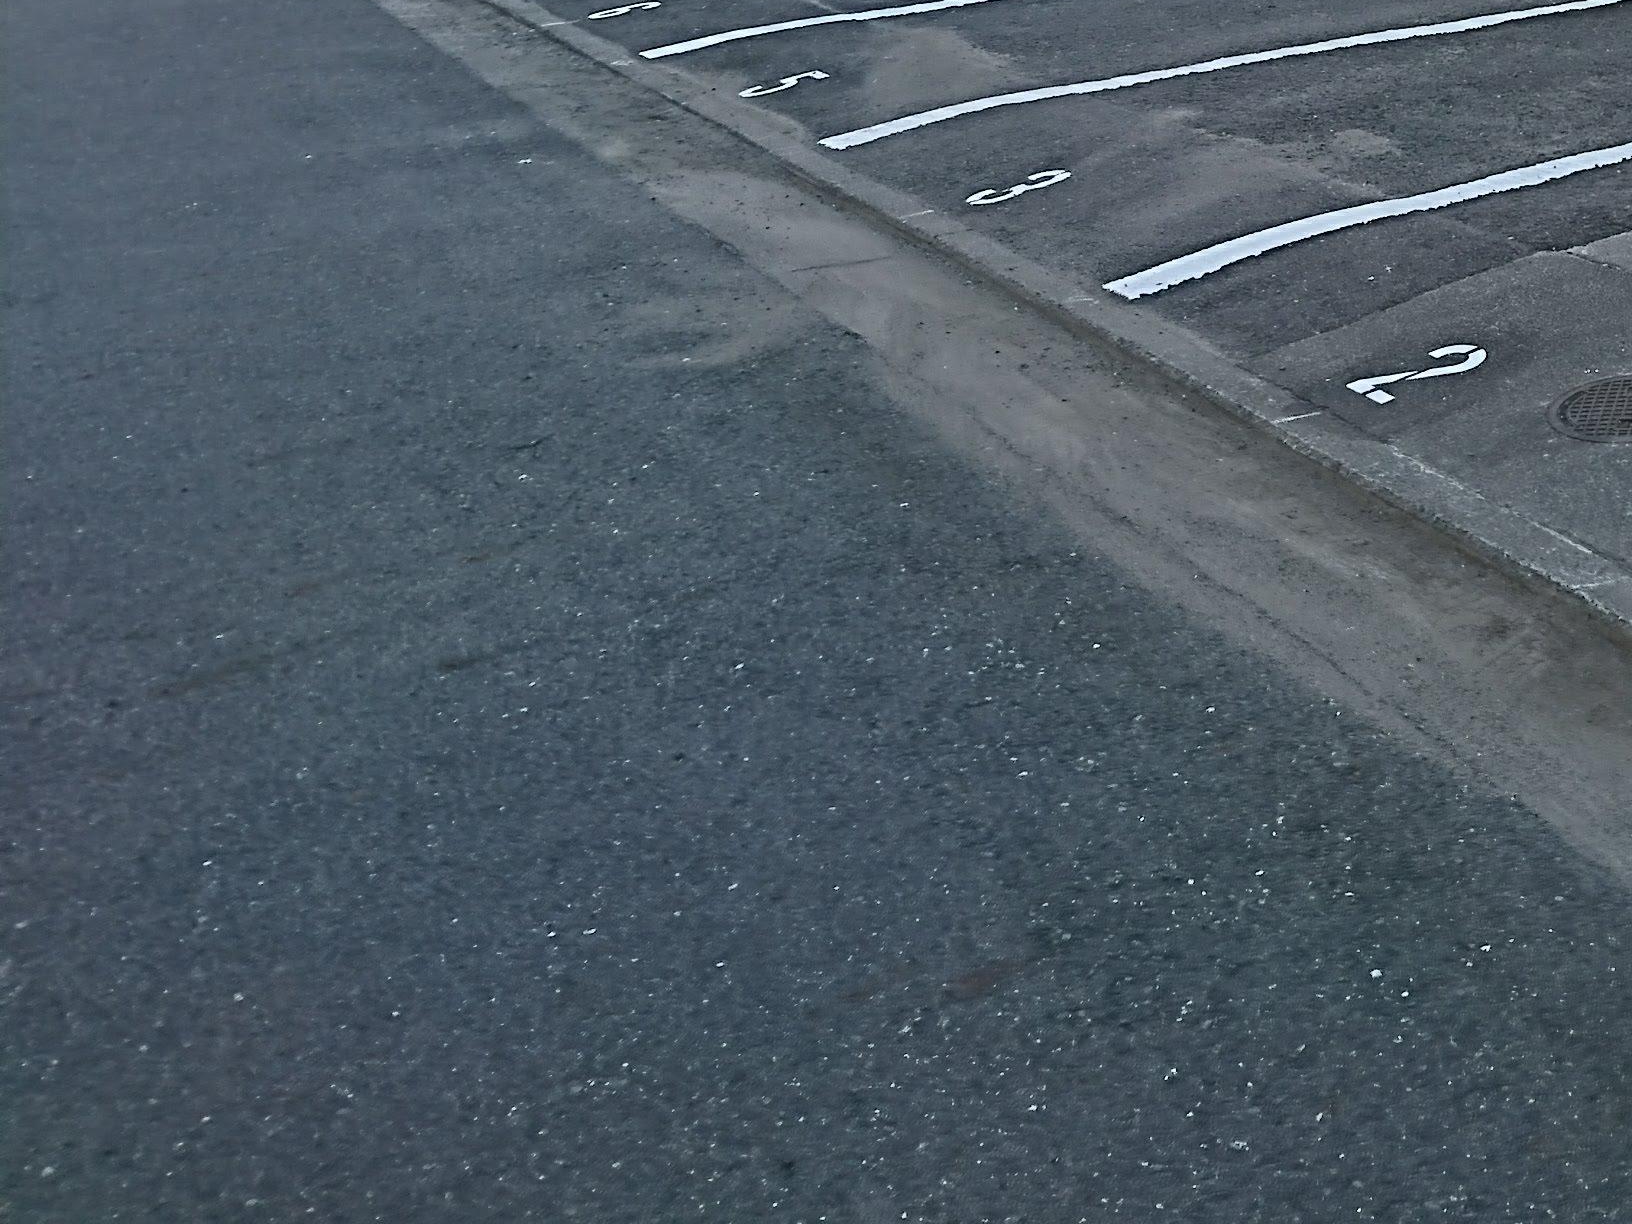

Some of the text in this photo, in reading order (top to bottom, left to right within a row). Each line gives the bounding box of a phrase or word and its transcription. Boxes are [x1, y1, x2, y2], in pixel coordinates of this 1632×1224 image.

[588, 1, 662, 19] 6
[739, 70, 830, 97] 5
[966, 169, 1071, 205] 3
[1345, 343, 1487, 405] 2
